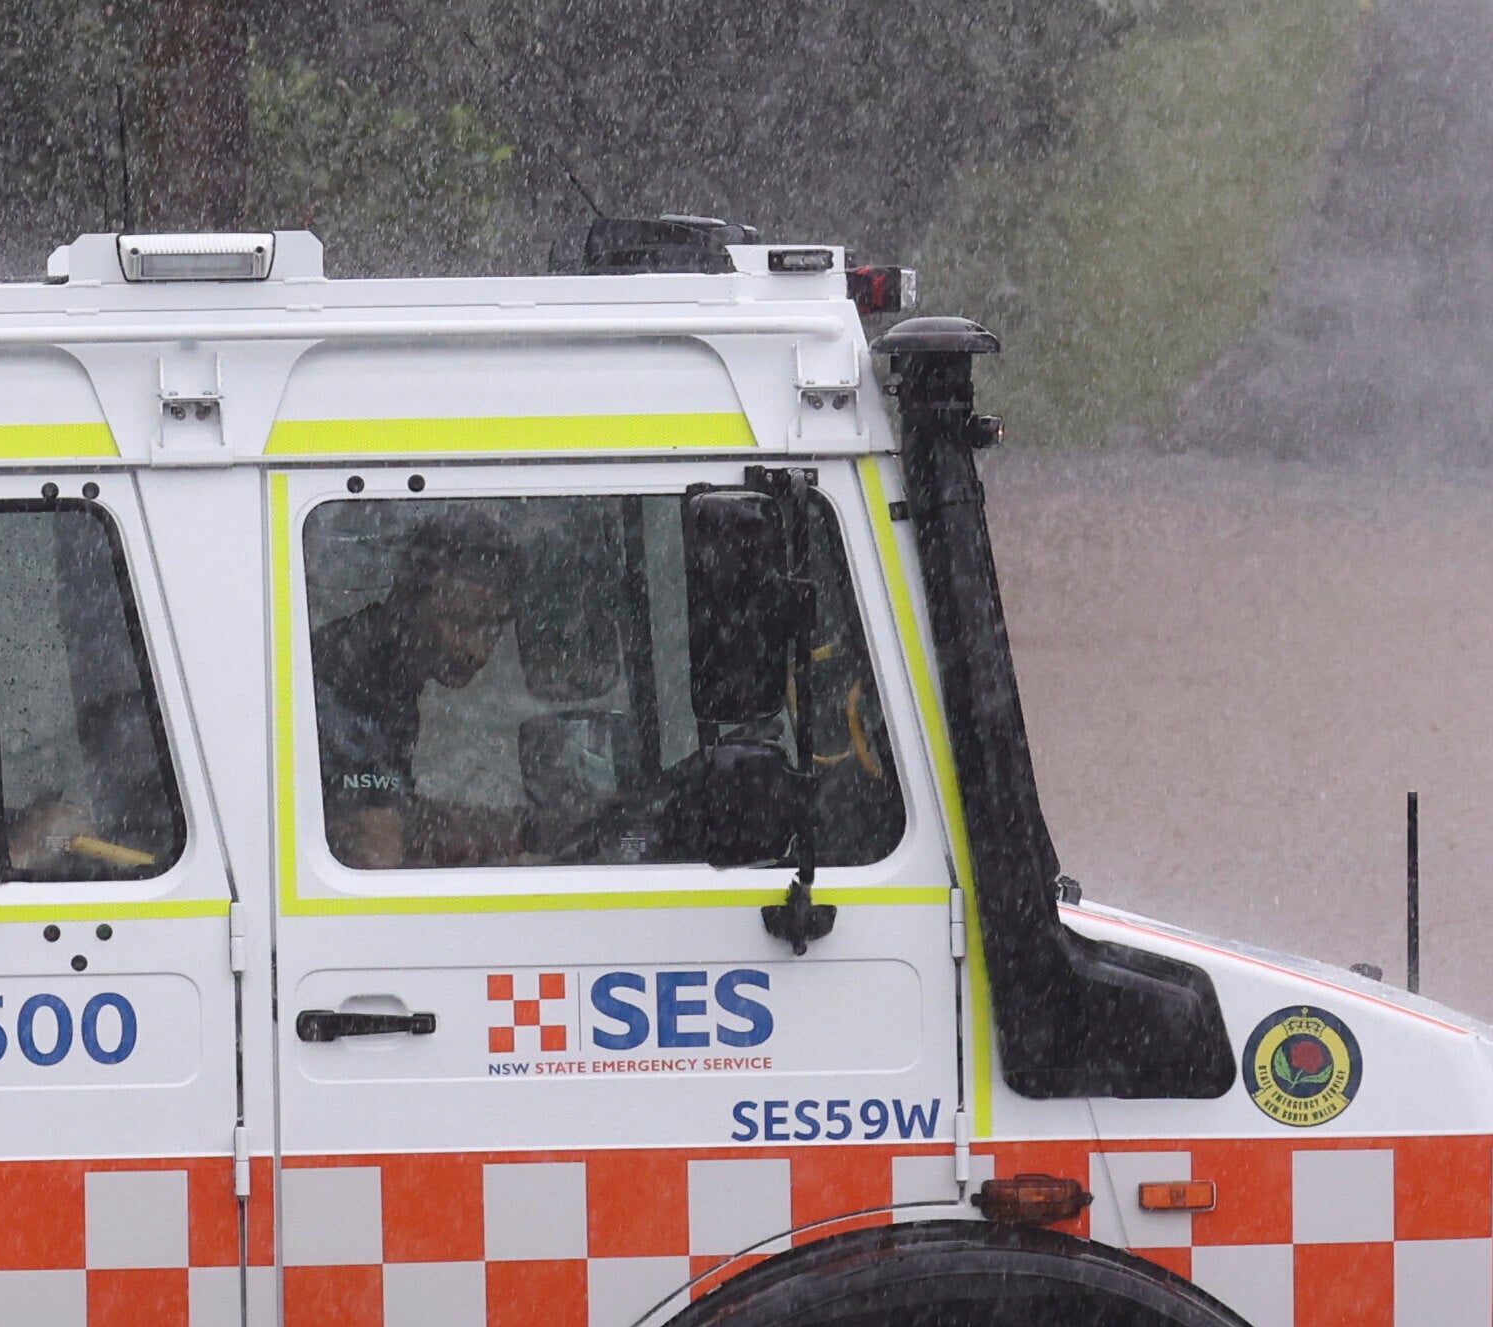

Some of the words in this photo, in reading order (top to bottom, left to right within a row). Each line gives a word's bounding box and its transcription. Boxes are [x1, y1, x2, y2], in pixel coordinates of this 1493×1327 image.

[590, 969, 774, 1050] SES
[488, 1062, 531, 1076] NSW
[534, 1061, 587, 1075] STATE
[591, 1058, 698, 1074] EMERGENCY
[702, 1056, 773, 1072] SERVICE
[730, 1098, 941, 1141] SES59W
